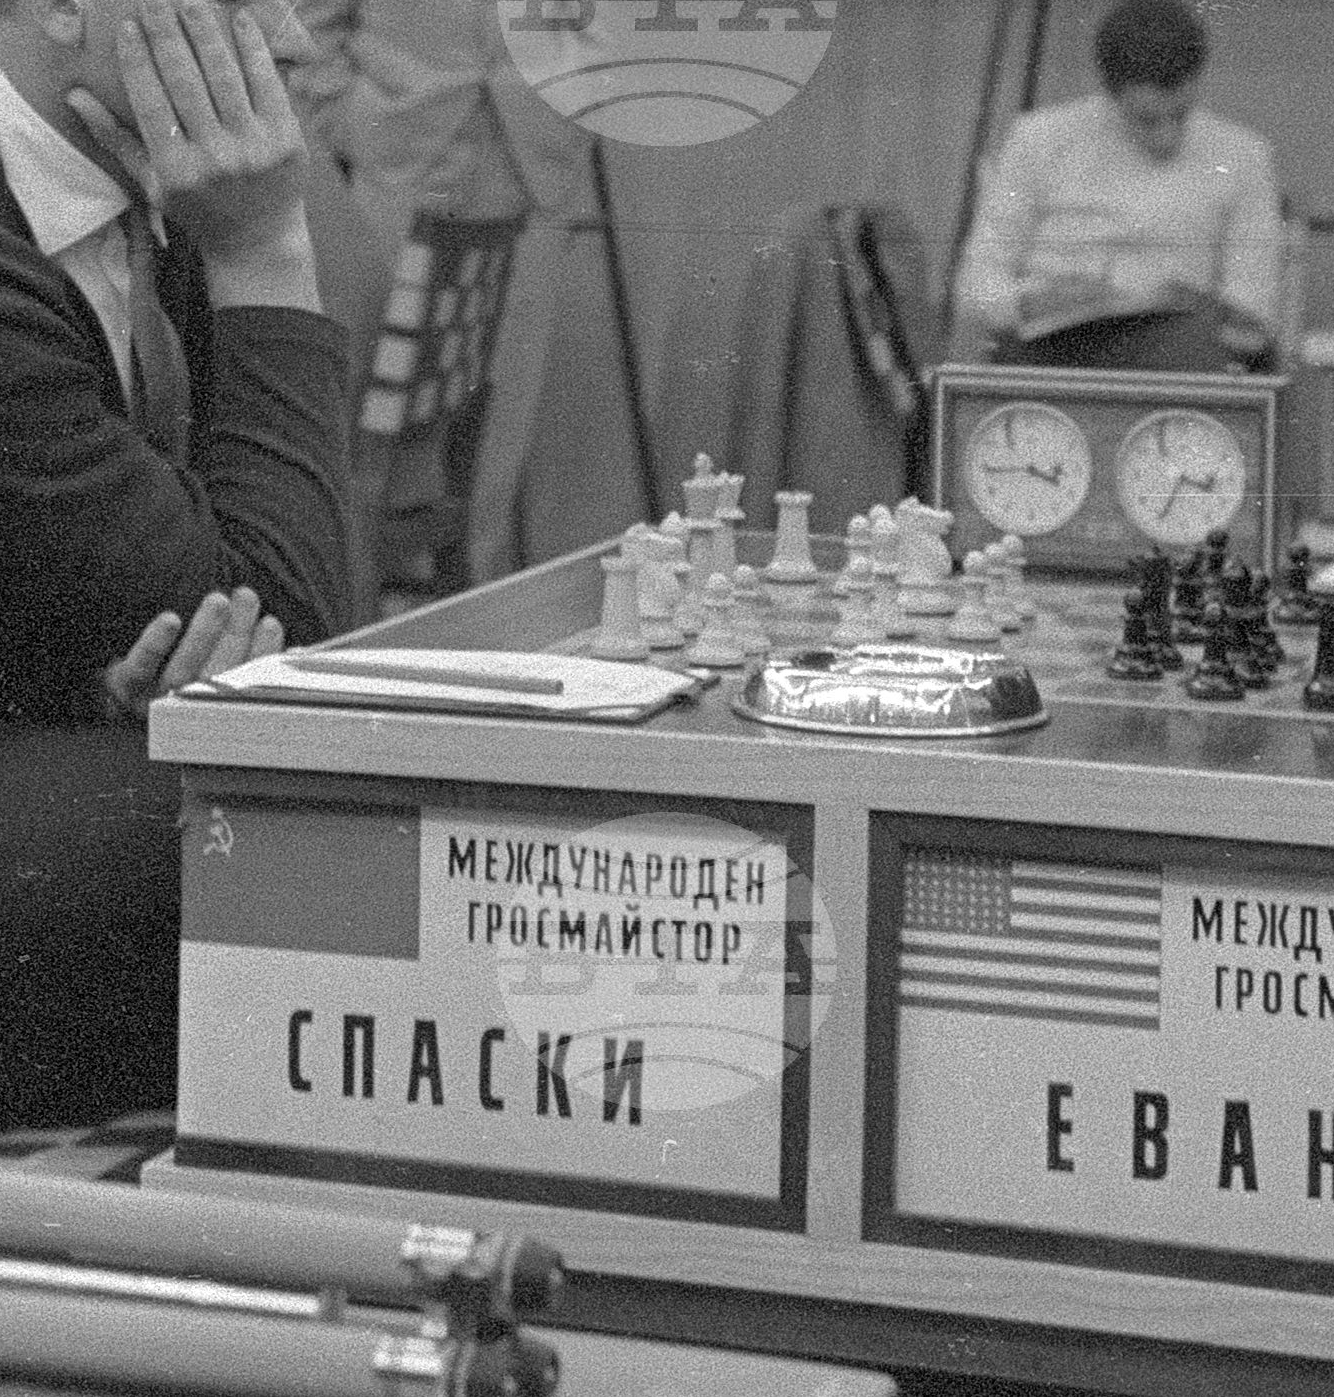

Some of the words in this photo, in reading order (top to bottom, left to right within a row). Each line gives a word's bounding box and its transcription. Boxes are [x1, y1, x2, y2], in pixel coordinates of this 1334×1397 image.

[447, 836, 766, 911] МЕЖДУНАРОДЕН
[468, 899, 743, 964] ГРОСМАЙСТОР
[287, 1009, 645, 1126] СПАСКИ
